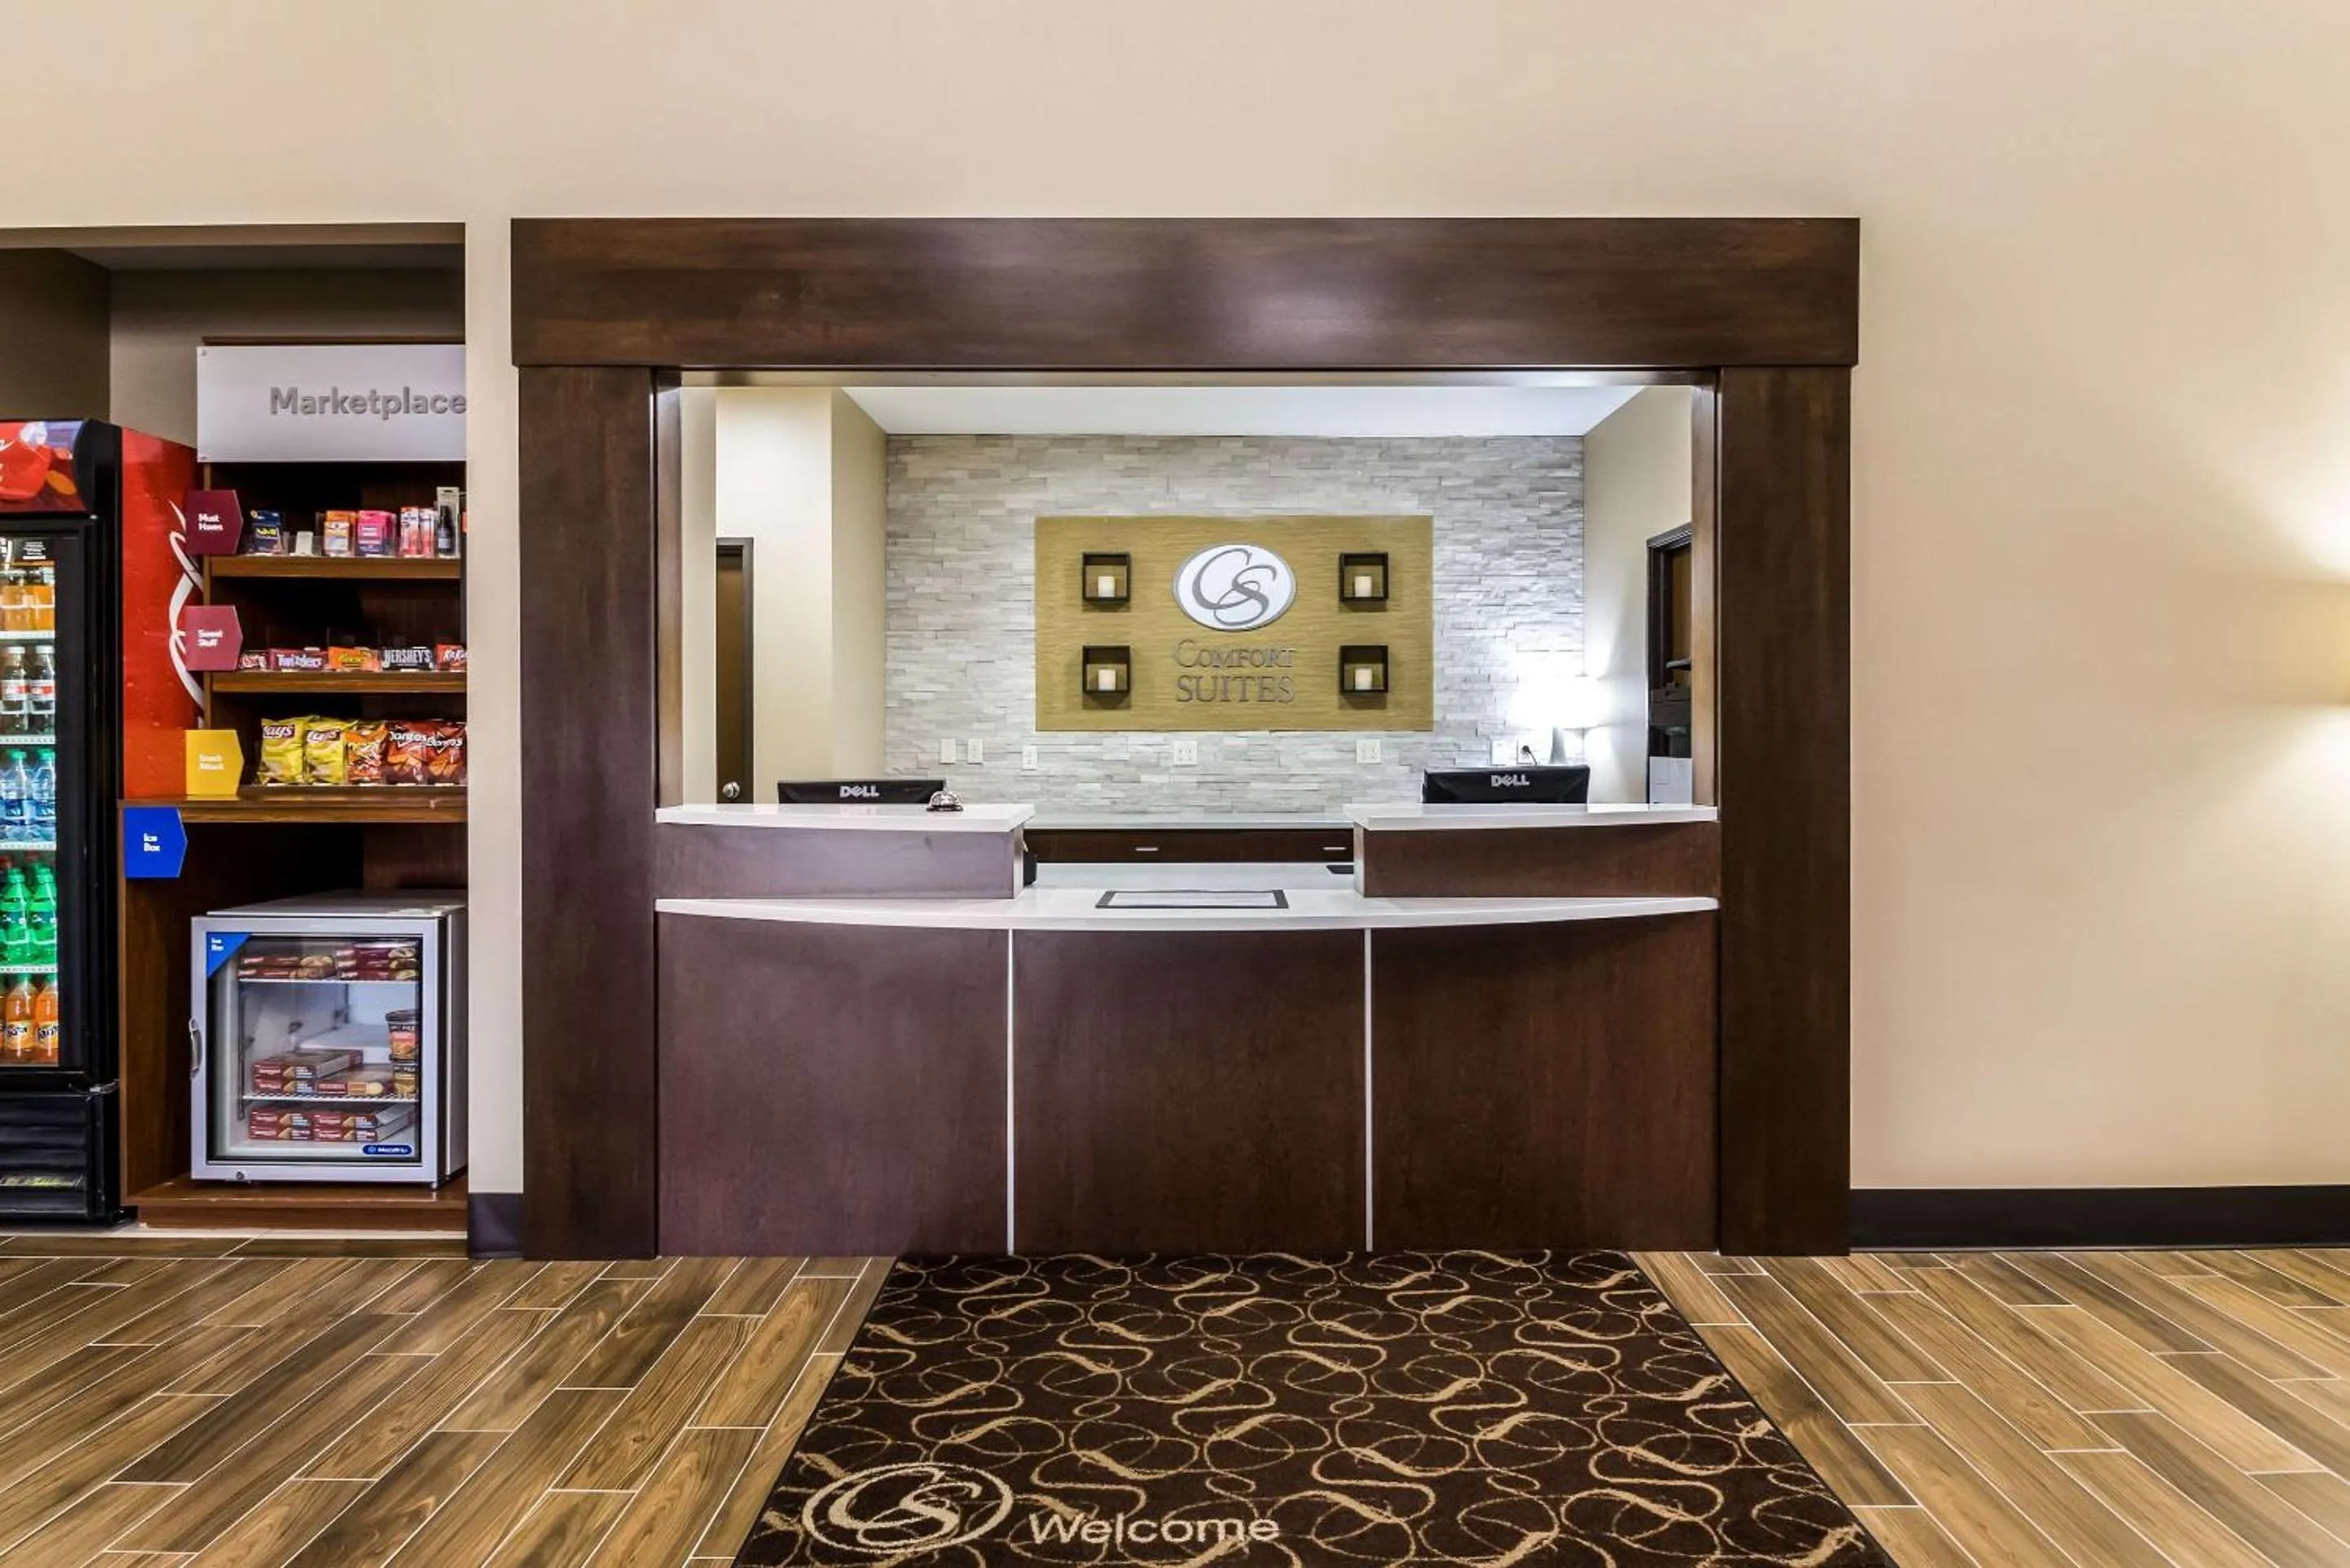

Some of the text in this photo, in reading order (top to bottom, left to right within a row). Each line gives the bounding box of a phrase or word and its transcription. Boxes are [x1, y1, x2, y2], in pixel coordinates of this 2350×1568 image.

[270, 385, 466, 420] Marketplace
[1176, 674, 1295, 704] SUITES
[839, 785, 880, 797] DELL
[1490, 774, 1530, 787] DELL
[144, 842, 161, 851] Box
[1029, 1512, 1280, 1544] Welcome
